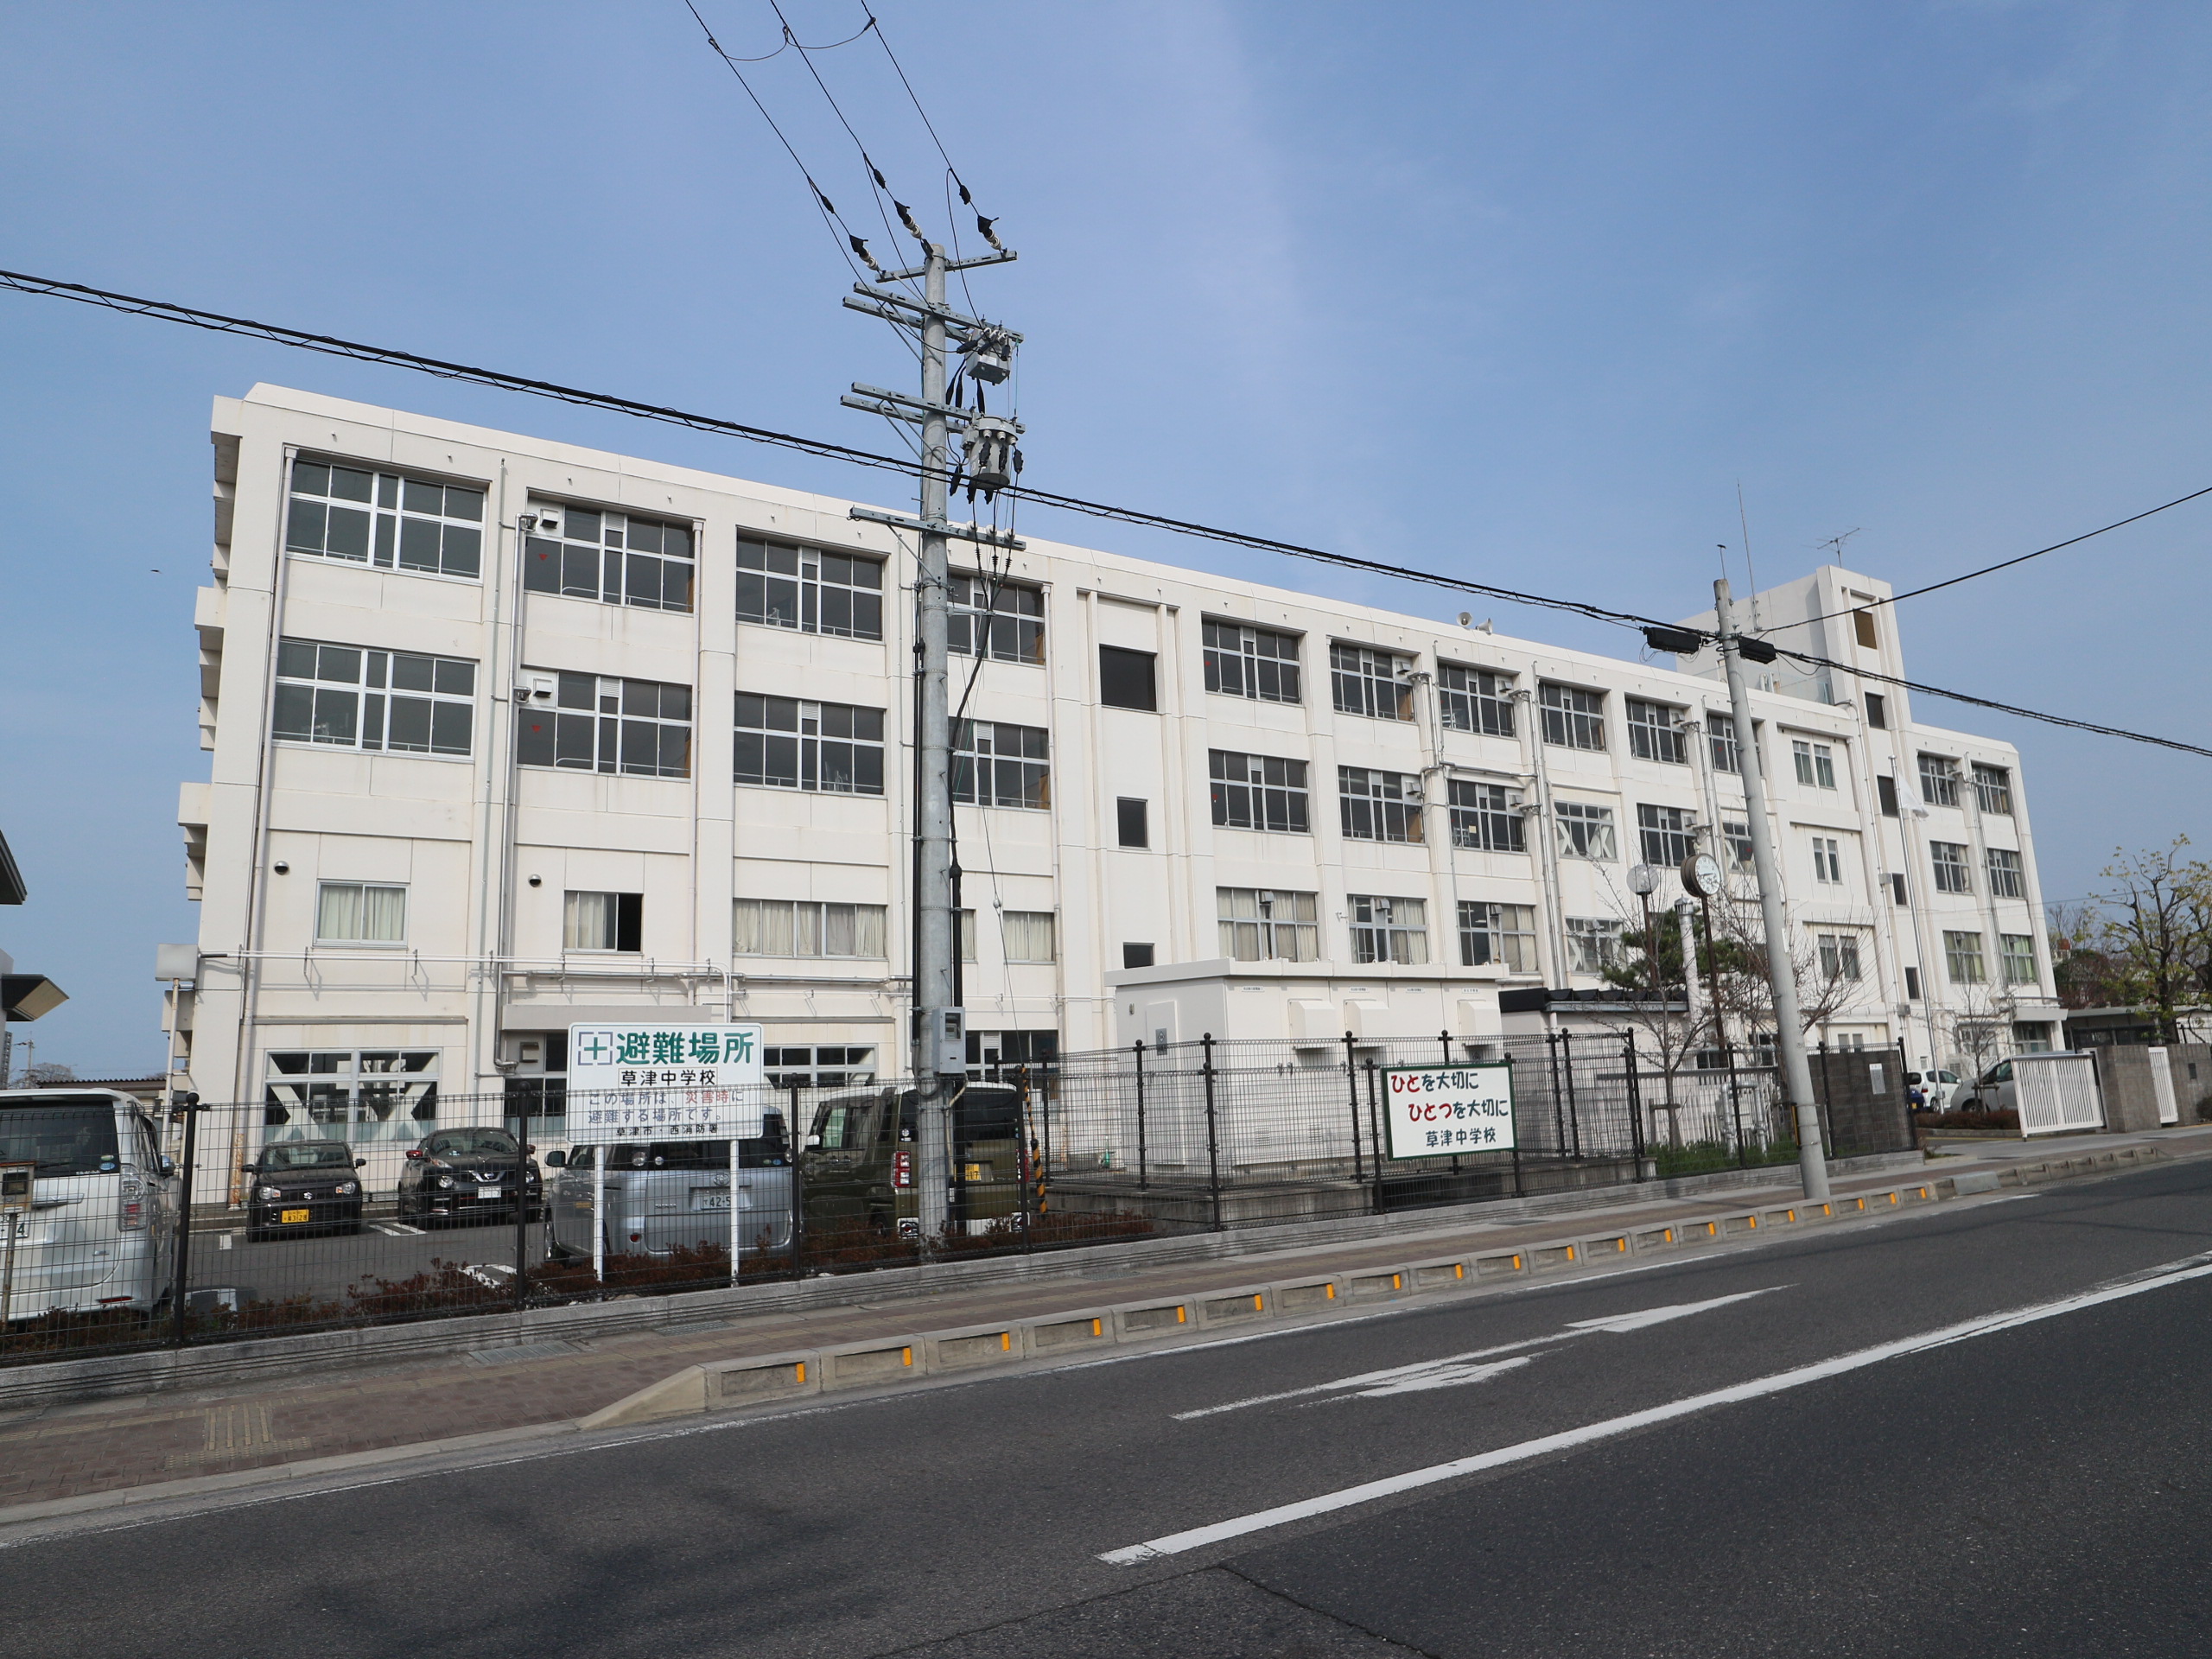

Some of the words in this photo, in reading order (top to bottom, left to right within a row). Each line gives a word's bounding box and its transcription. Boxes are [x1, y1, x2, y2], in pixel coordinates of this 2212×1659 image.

[616, 1031, 754, 1065] 避難場所
[620, 1069, 715, 1087] 草津中学校
[1391, 1071, 1479, 1093] ひとを大切に
[588, 1106, 721, 1124] 避難する場所です。
[1408, 1098, 1509, 1122] ひとつを大切に
[1426, 1126, 1497, 1147] 草津中学校
[709, 1196, 731, 1207] 42-5
